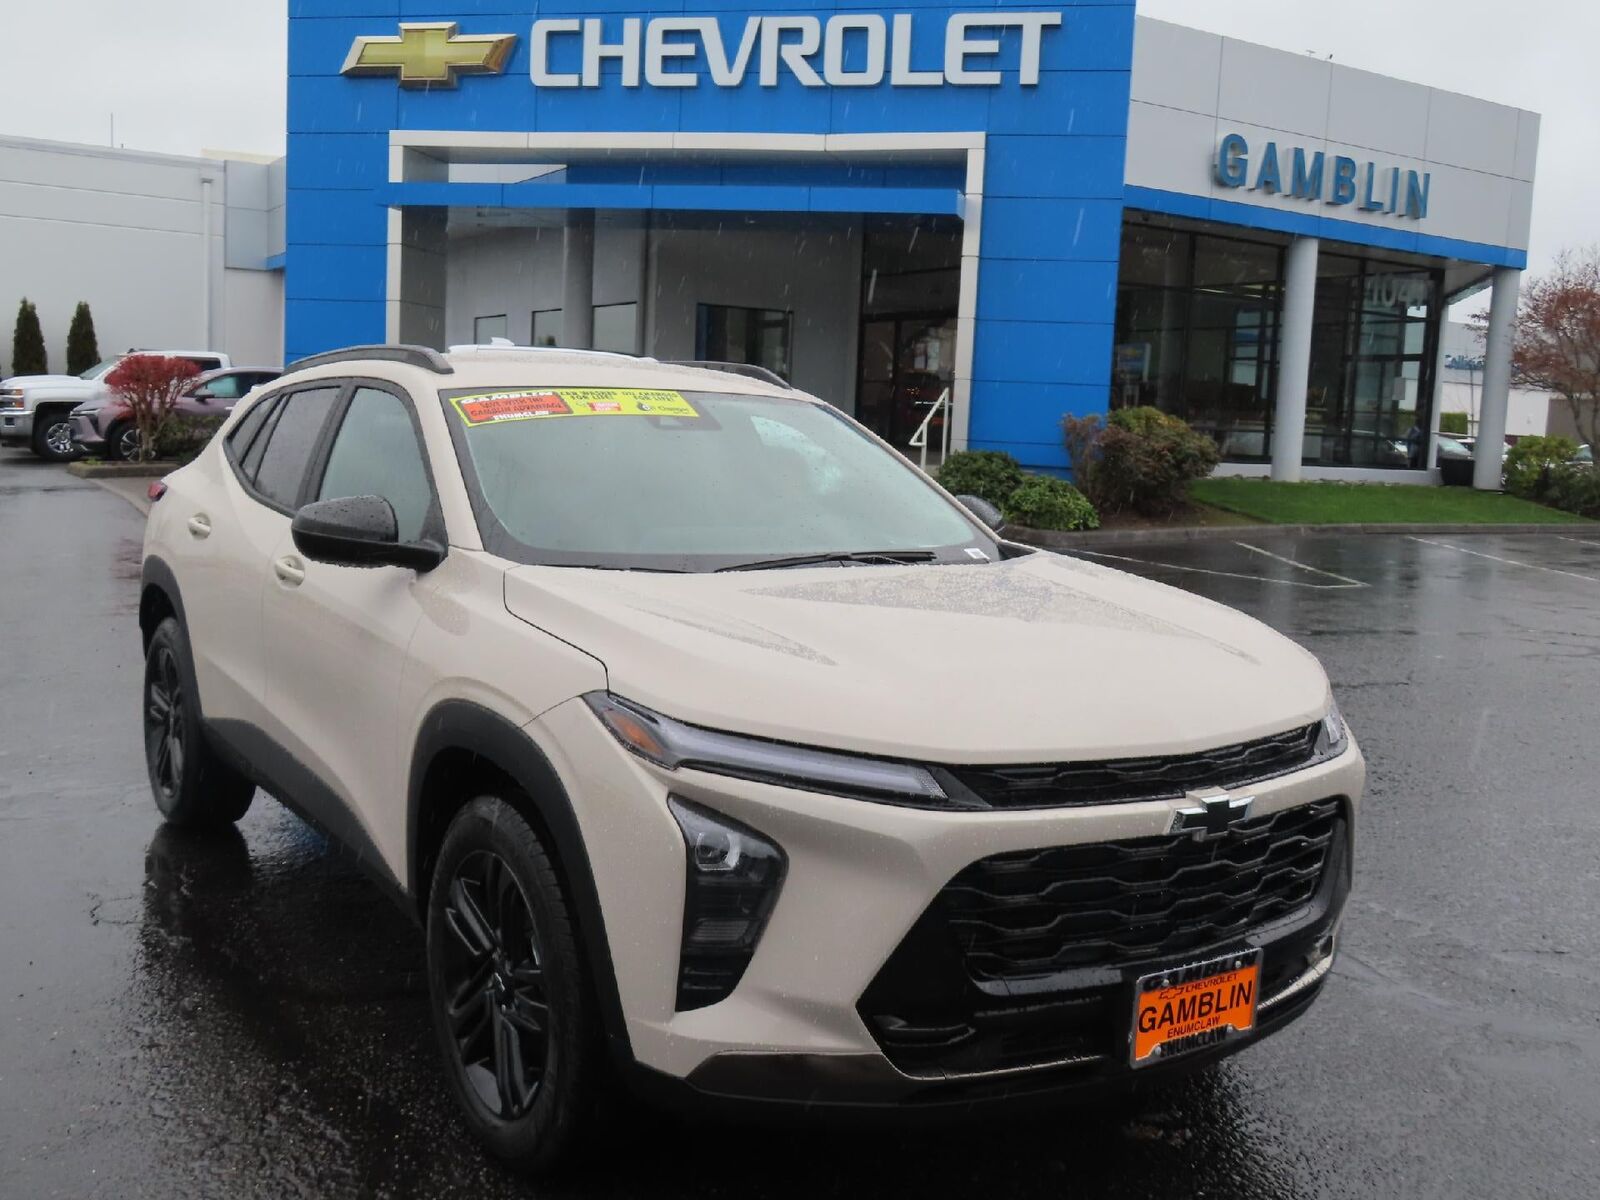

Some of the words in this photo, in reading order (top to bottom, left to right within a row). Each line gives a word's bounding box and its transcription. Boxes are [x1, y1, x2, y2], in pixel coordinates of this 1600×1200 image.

[530, 12, 1062, 87] CHEVROLET
[1217, 133, 1430, 219] GAMBLIN
[1138, 980, 1253, 1033] GAMBLIN
[1185, 973, 1238, 993] CHEVROLET
[1167, 1016, 1221, 1038] ENUMCLAW
